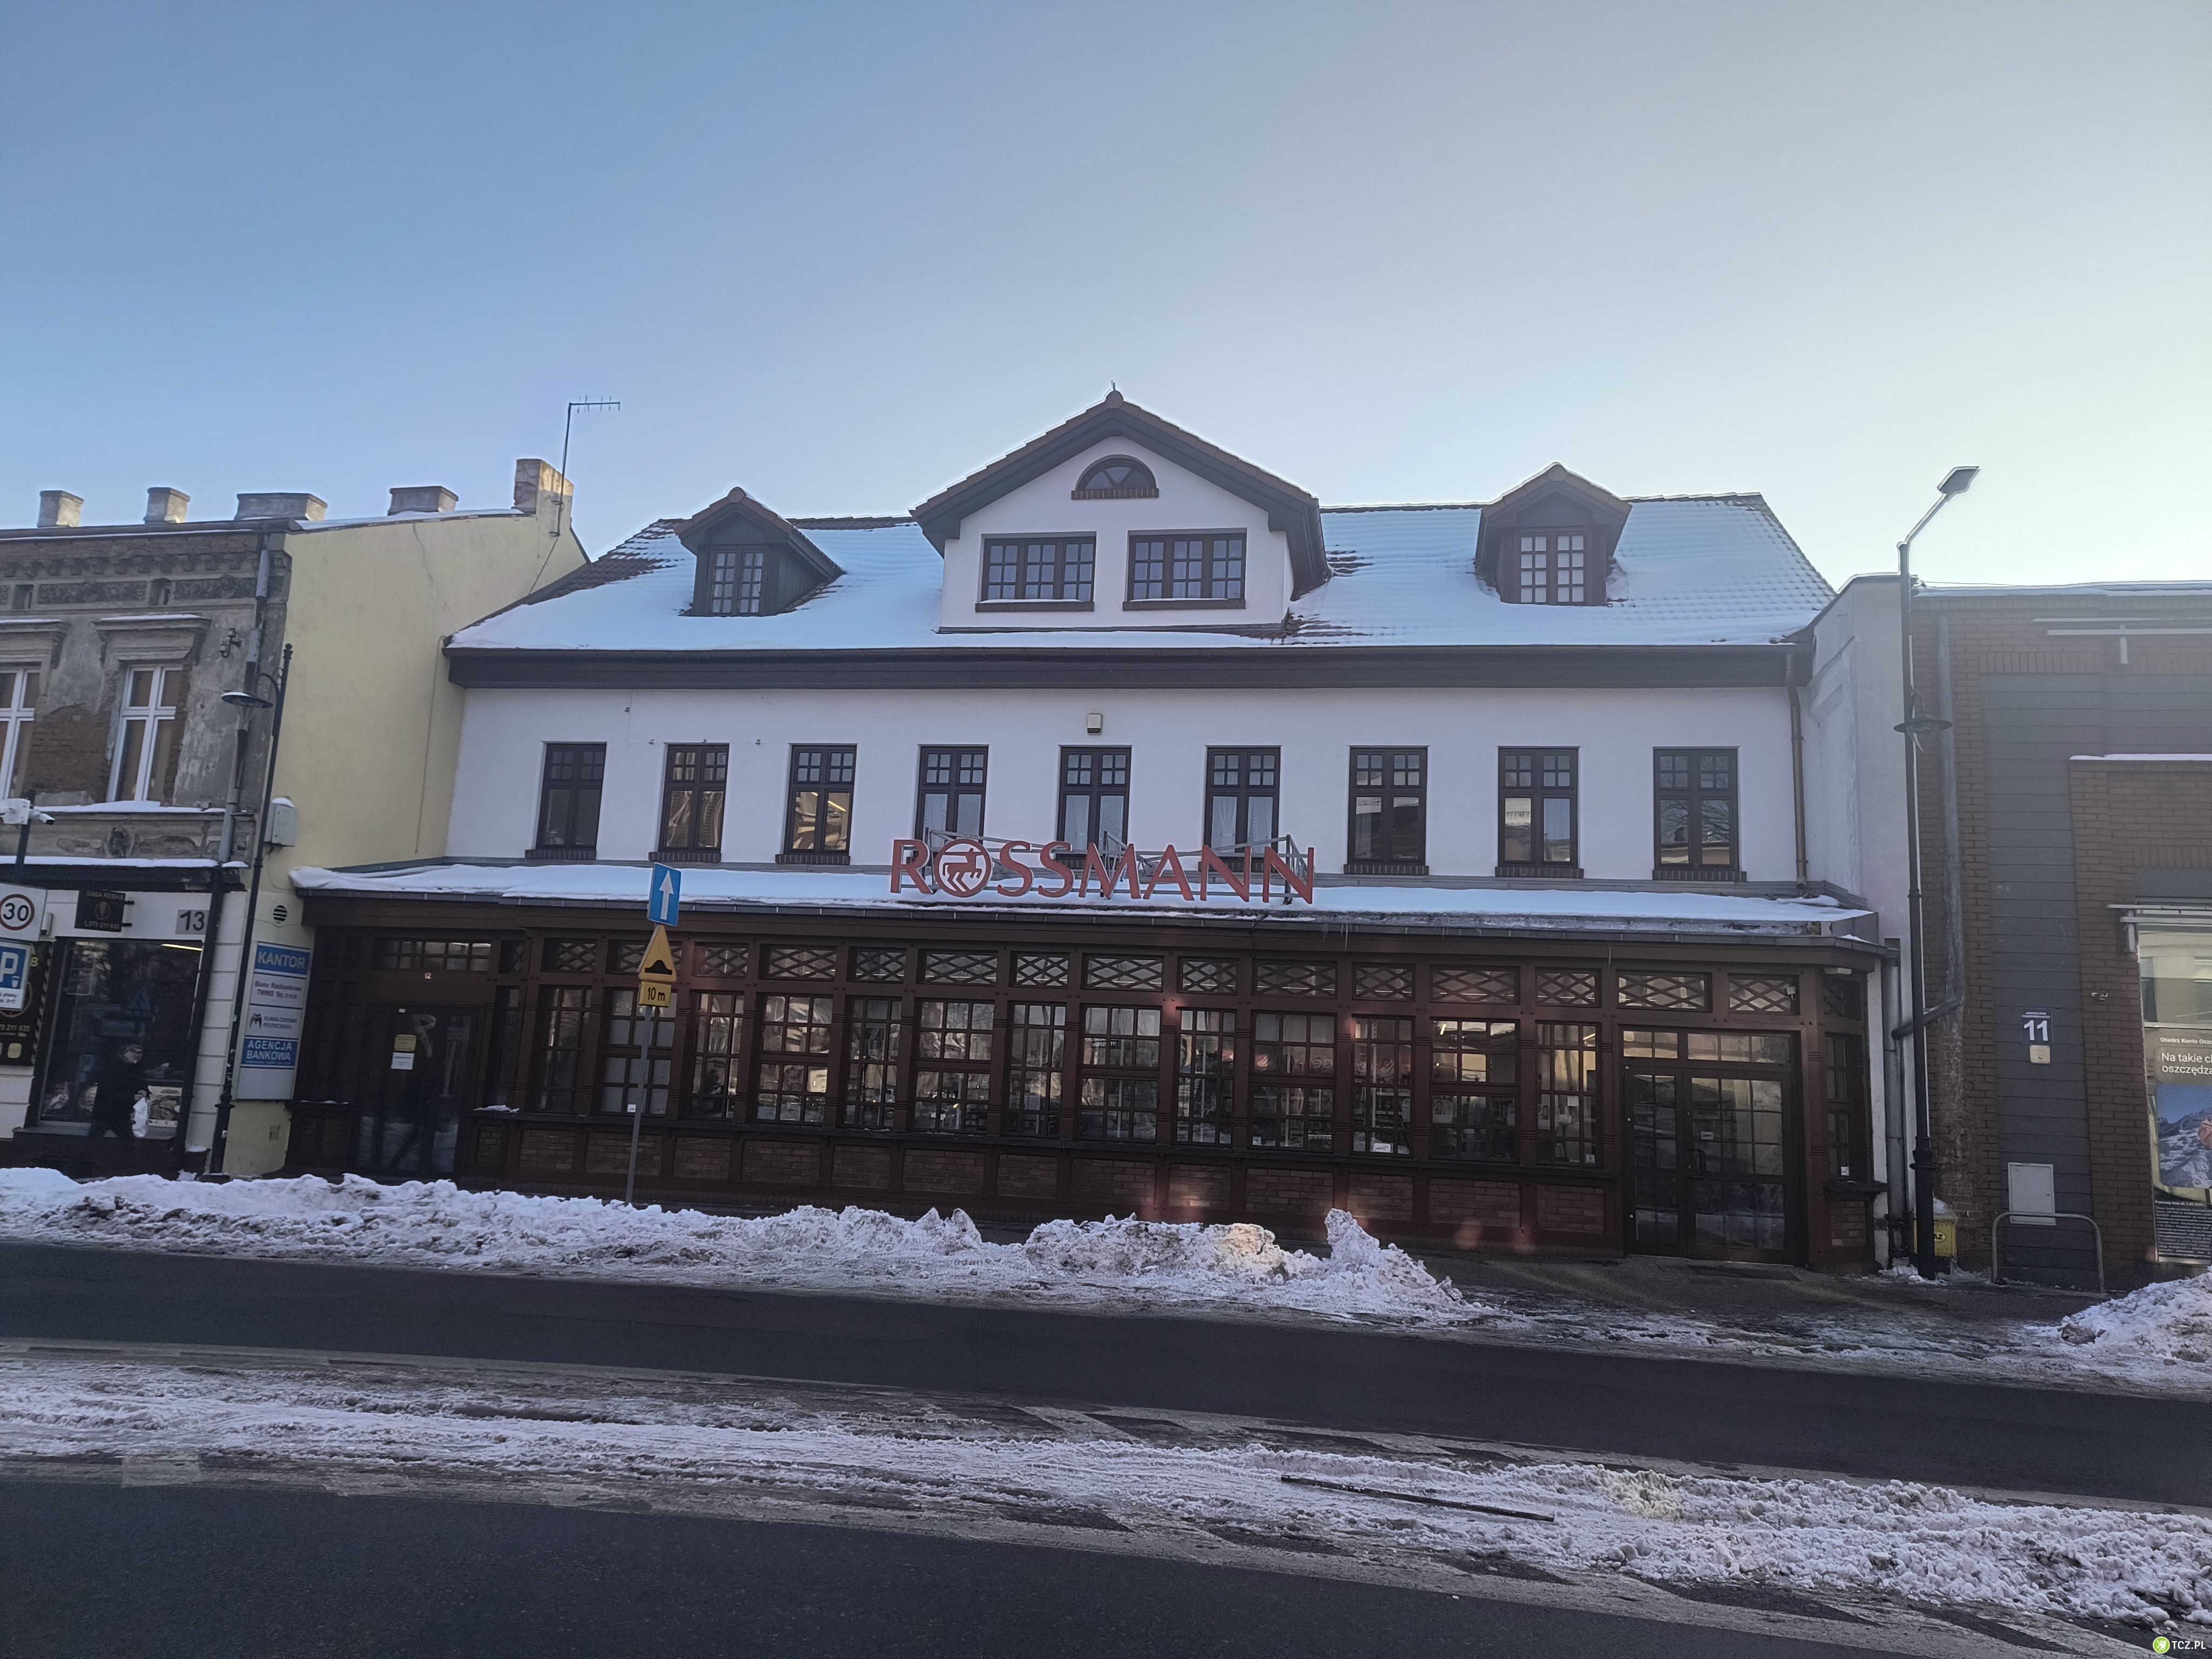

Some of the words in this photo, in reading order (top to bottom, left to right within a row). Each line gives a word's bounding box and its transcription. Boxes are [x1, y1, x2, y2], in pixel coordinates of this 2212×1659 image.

[889, 839, 1314, 905] ROSSMANN
[3, 902, 29, 921] 30
[180, 910, 205, 931] 13
[257, 951, 306, 969] KANTOR
[648, 987, 656, 1000] 10
[657, 992, 665, 1002] m
[2024, 1020, 2048, 1041] 11
[247, 1040, 293, 1051] AGENCJA
[246, 1049, 291, 1061] BANKOWA
[2161, 1052, 2176, 1062] Na
[2178, 1053, 2203, 1063] takie
